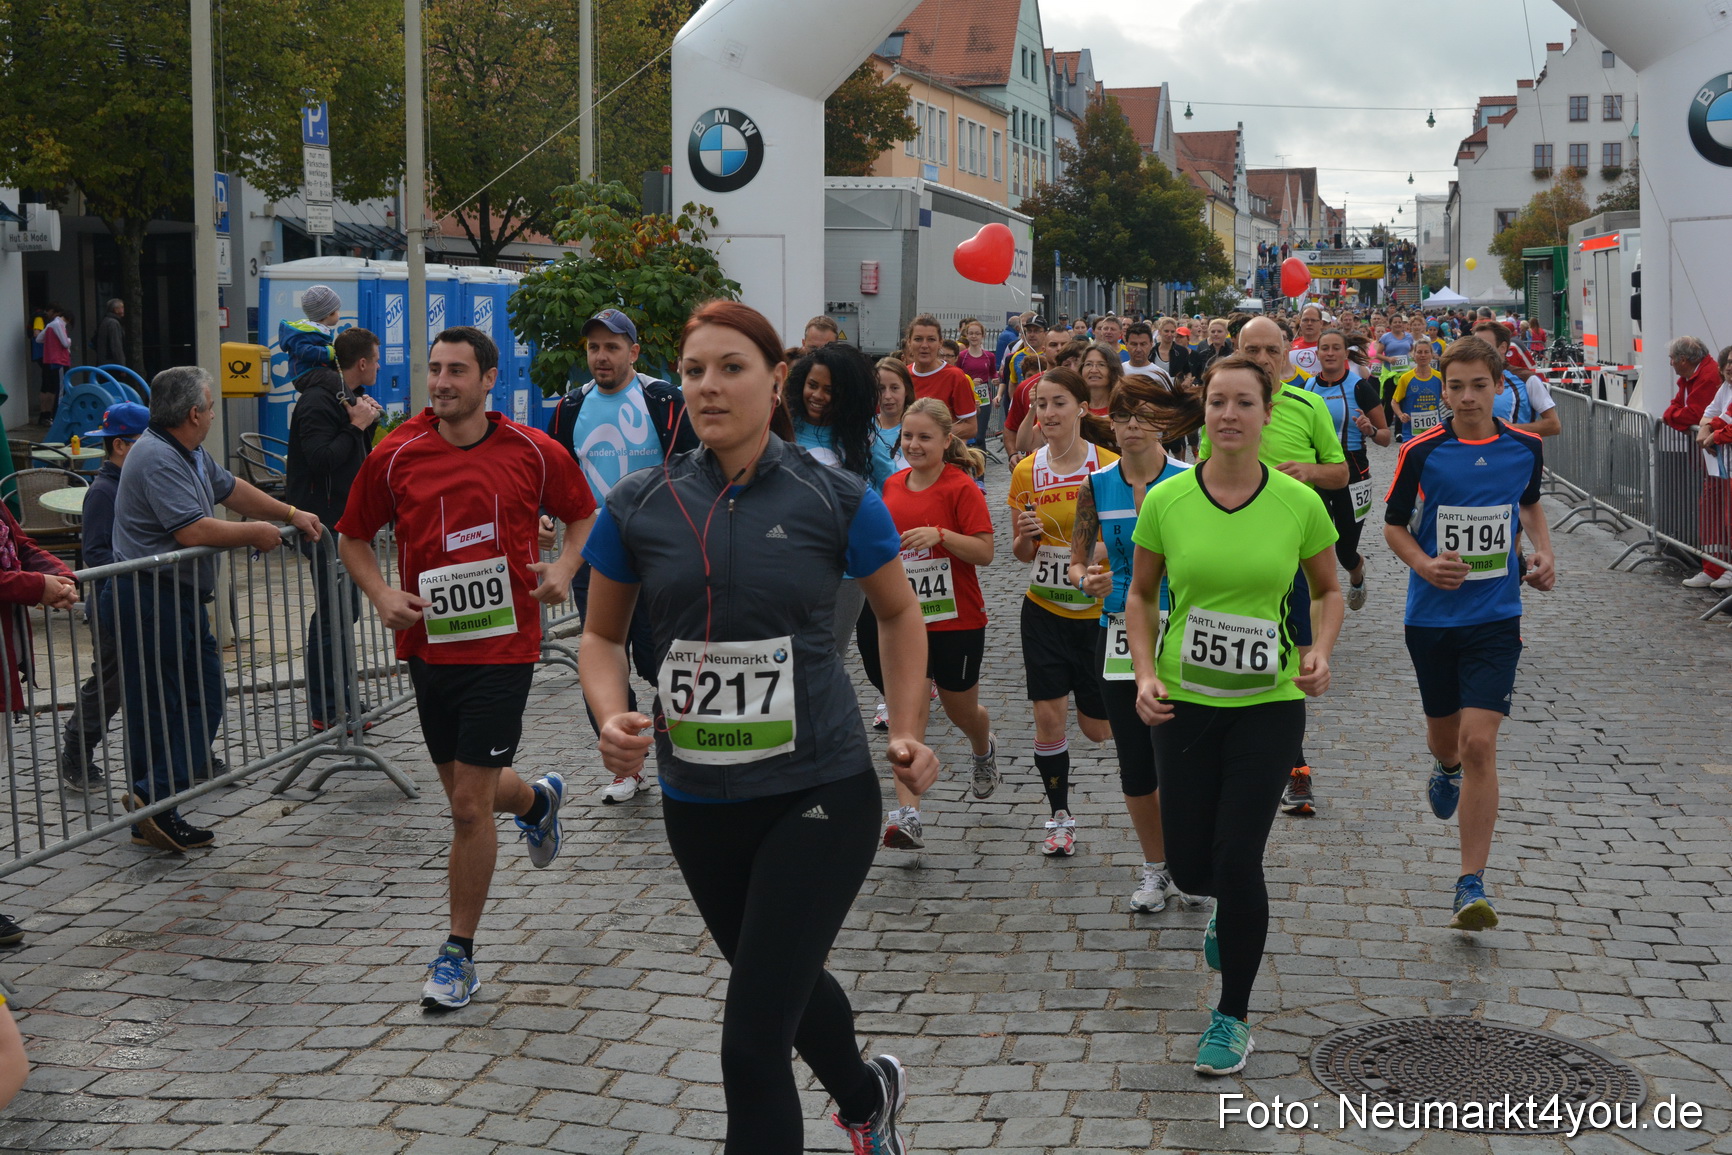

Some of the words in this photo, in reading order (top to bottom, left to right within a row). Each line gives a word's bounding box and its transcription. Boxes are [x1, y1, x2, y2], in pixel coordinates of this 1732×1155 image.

[692, 109, 758, 137] BMW
[9, 233, 21, 243] Hut
[30, 232, 48, 242] Mode
[250, 257, 258, 277] 3
[1321, 267, 1354, 276] START
[1413, 416, 1437, 428] 5103
[589, 447, 615, 457] anders
[616, 447, 628, 457] als
[629, 447, 659, 457] andere
[1034, 493, 1061, 505] MAX
[1439, 512, 1465, 521] PARTL
[1467, 513, 1502, 522] Neumarkt
[460, 530, 482, 543] DEHN
[1444, 523, 1506, 552] 5194
[902, 551, 919, 561] DEHN
[1053, 552, 1072, 560] Neum
[420, 574, 450, 585] PARTL
[451, 567, 493, 581] Neumarkt
[905, 565, 938, 574] Neumarkt
[1035, 560, 1073, 586] 515
[430, 577, 504, 615] 5009
[1049, 590, 1073, 602] Tanja
[921, 604, 941, 614] tina
[449, 614, 492, 631] Manuel
[1188, 614, 1216, 629] PARTL
[1217, 621, 1263, 637] Neumarkt
[1190, 629, 1269, 672] 5516
[666, 651, 701, 664] ARTL
[704, 653, 769, 665] Neumarkt
[670, 669, 780, 716] 5217
[696, 728, 753, 747] Carola
[801, 812, 829, 820] adidas
